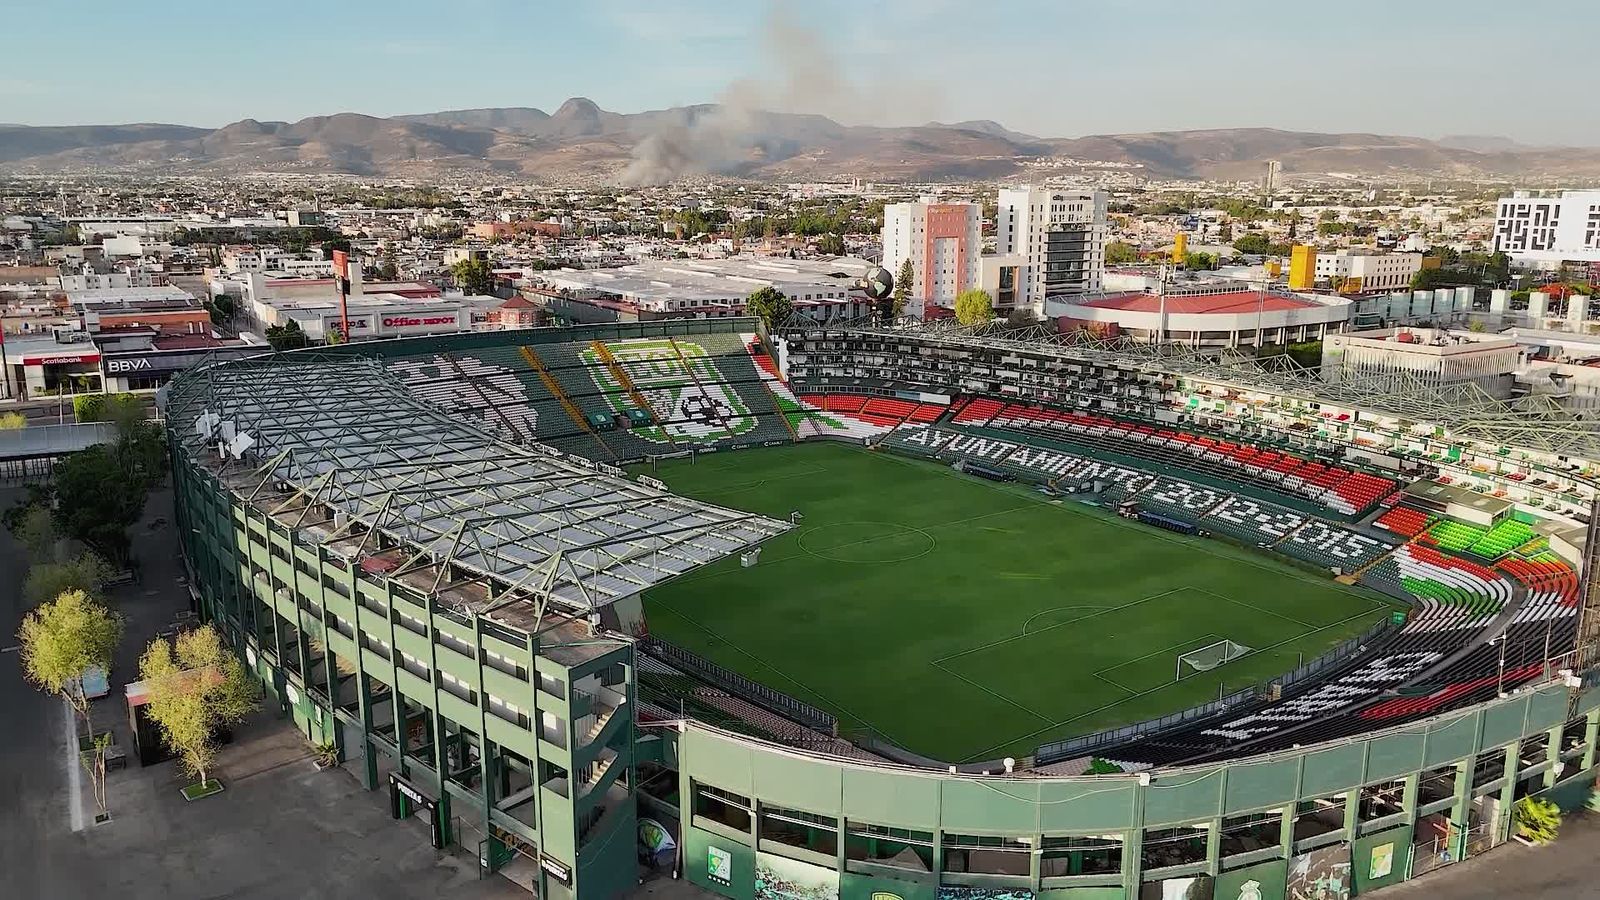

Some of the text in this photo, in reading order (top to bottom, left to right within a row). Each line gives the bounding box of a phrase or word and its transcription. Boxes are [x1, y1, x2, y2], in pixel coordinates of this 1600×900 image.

[330, 320, 356, 329] peco
[383, 317, 421, 328] Office
[41, 356, 82, 365] Scotiabank
[109, 358, 152, 373] BBVA
